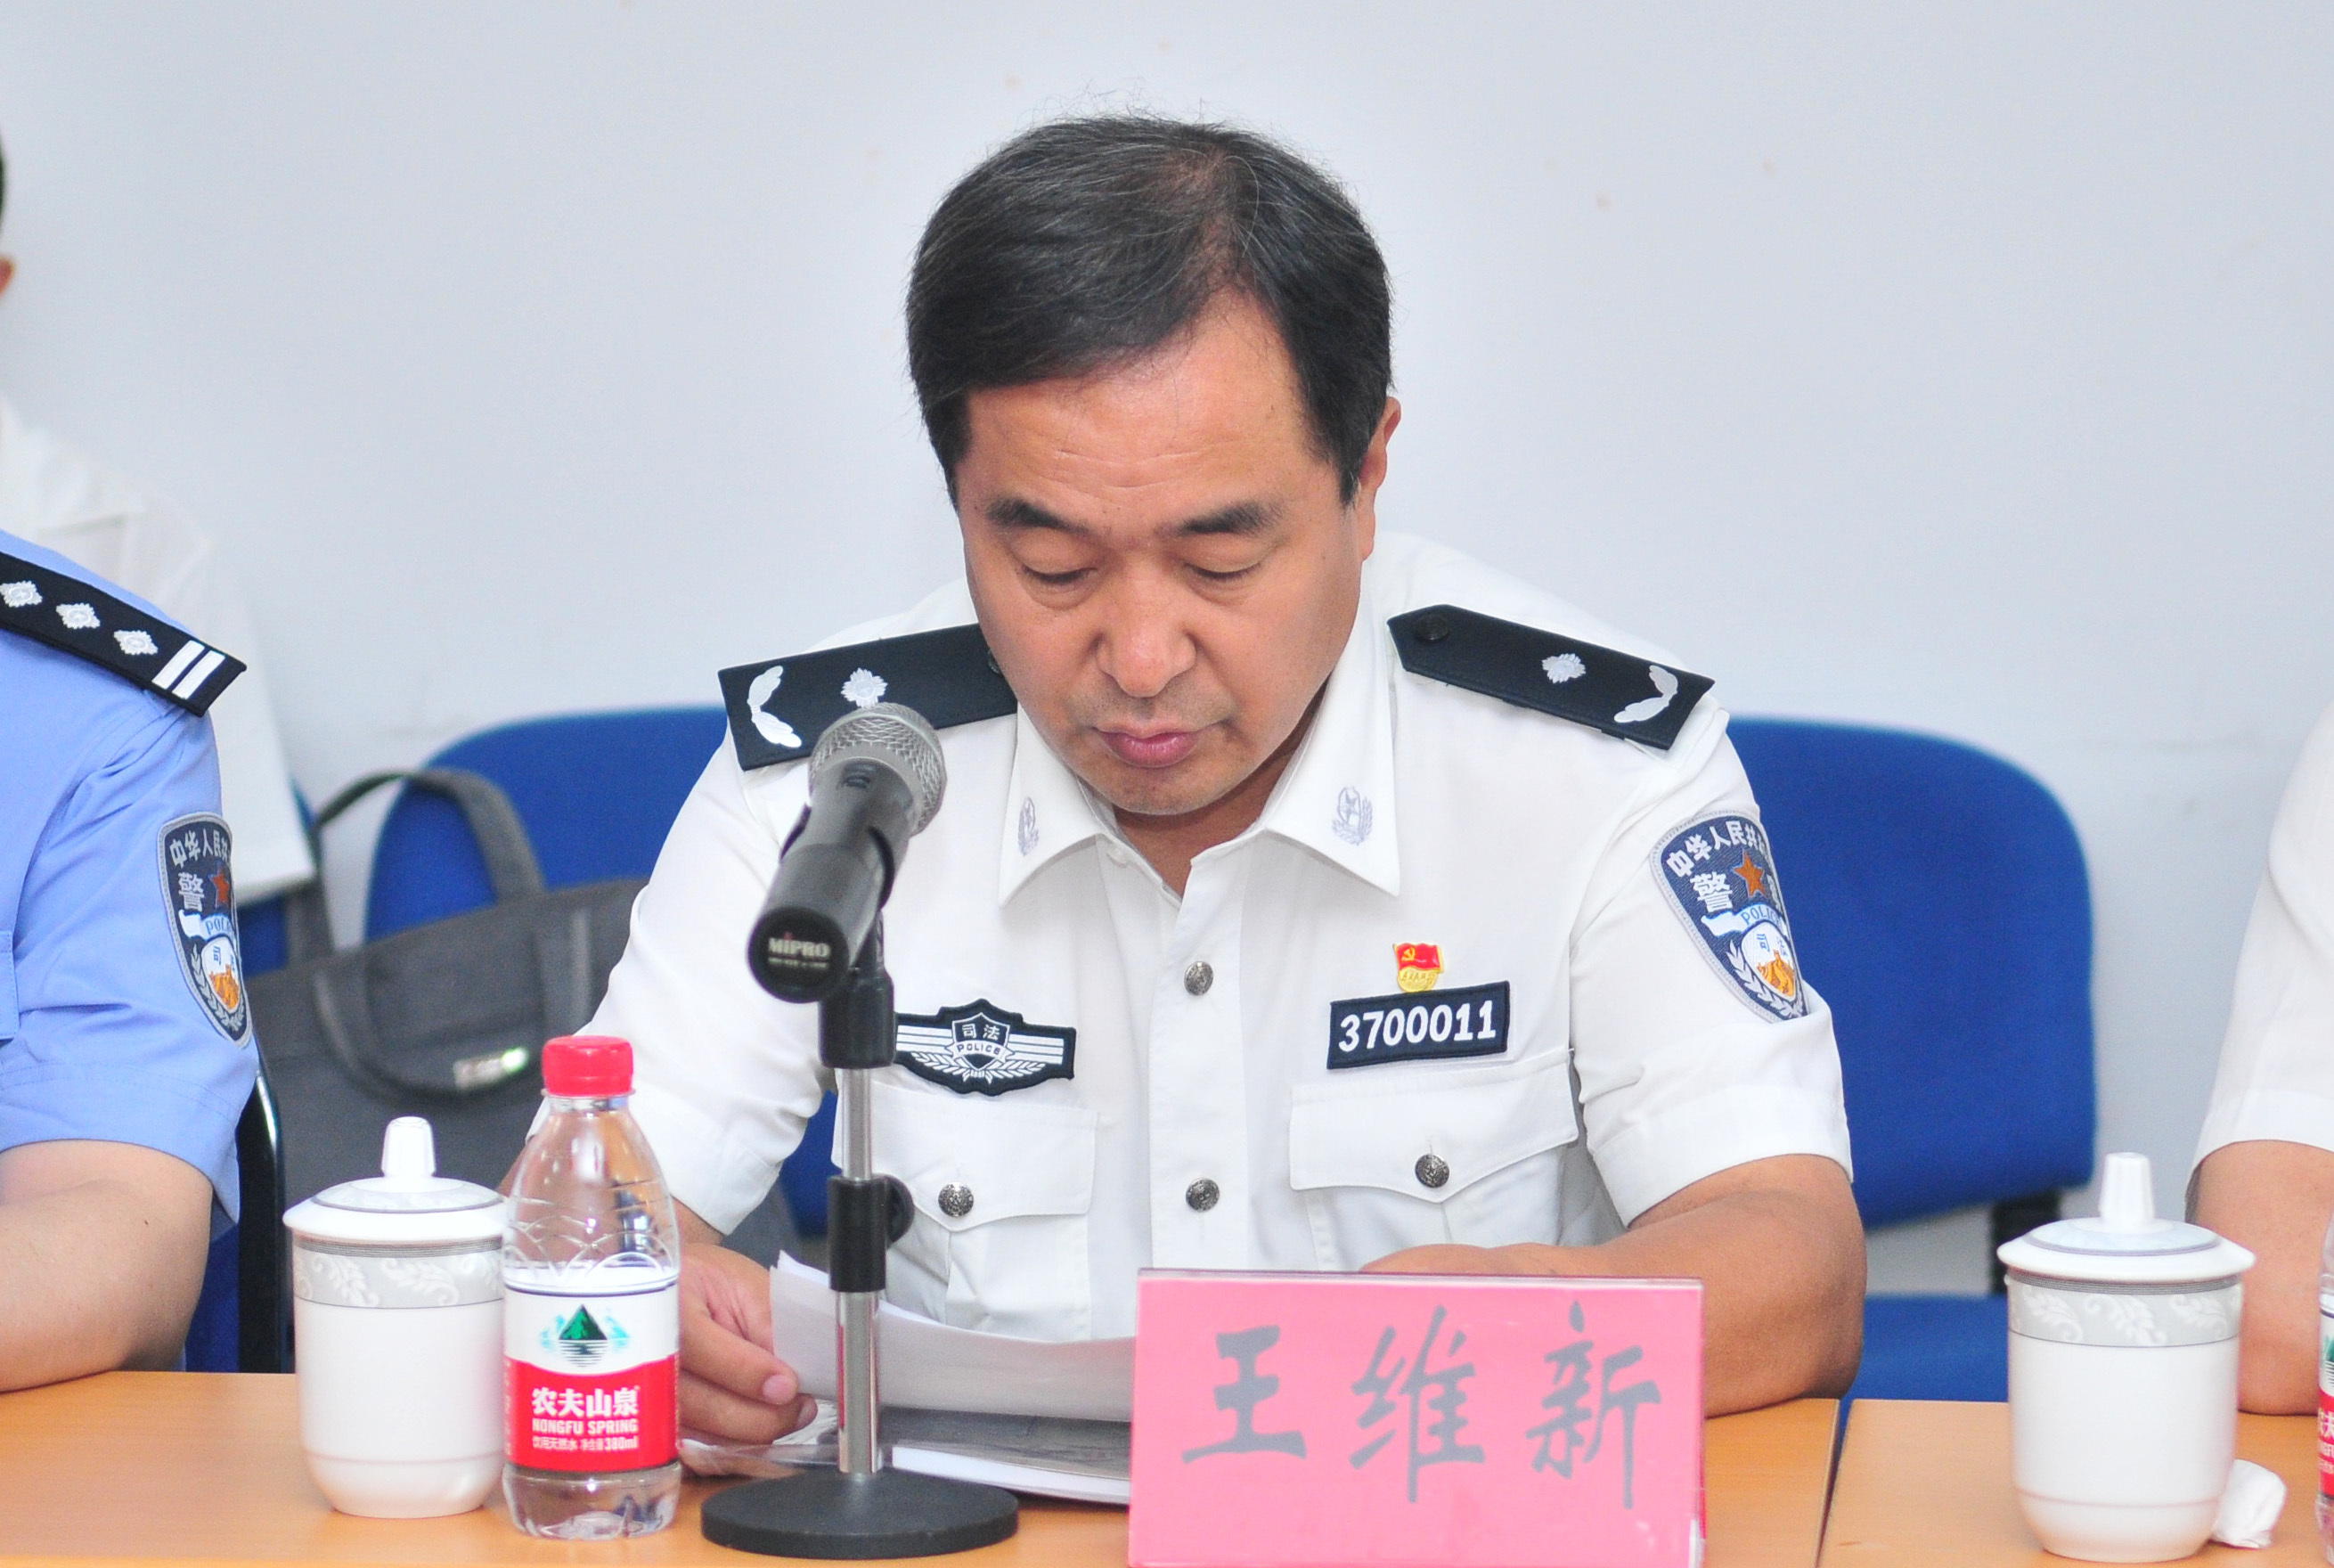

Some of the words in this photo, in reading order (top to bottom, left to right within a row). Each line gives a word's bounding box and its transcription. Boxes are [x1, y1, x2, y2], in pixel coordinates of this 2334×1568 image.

[961, 1023, 1000, 1041] 司法
[1338, 1000, 1497, 1052] 3700011
[956, 1042, 1000, 1055] POLICE
[532, 1386, 639, 1417] 农夫山泉
[1180, 1300, 1661, 1510] 王维新
[532, 1417, 584, 1435] NONGFU
[587, 1418, 639, 1435] SPRING
